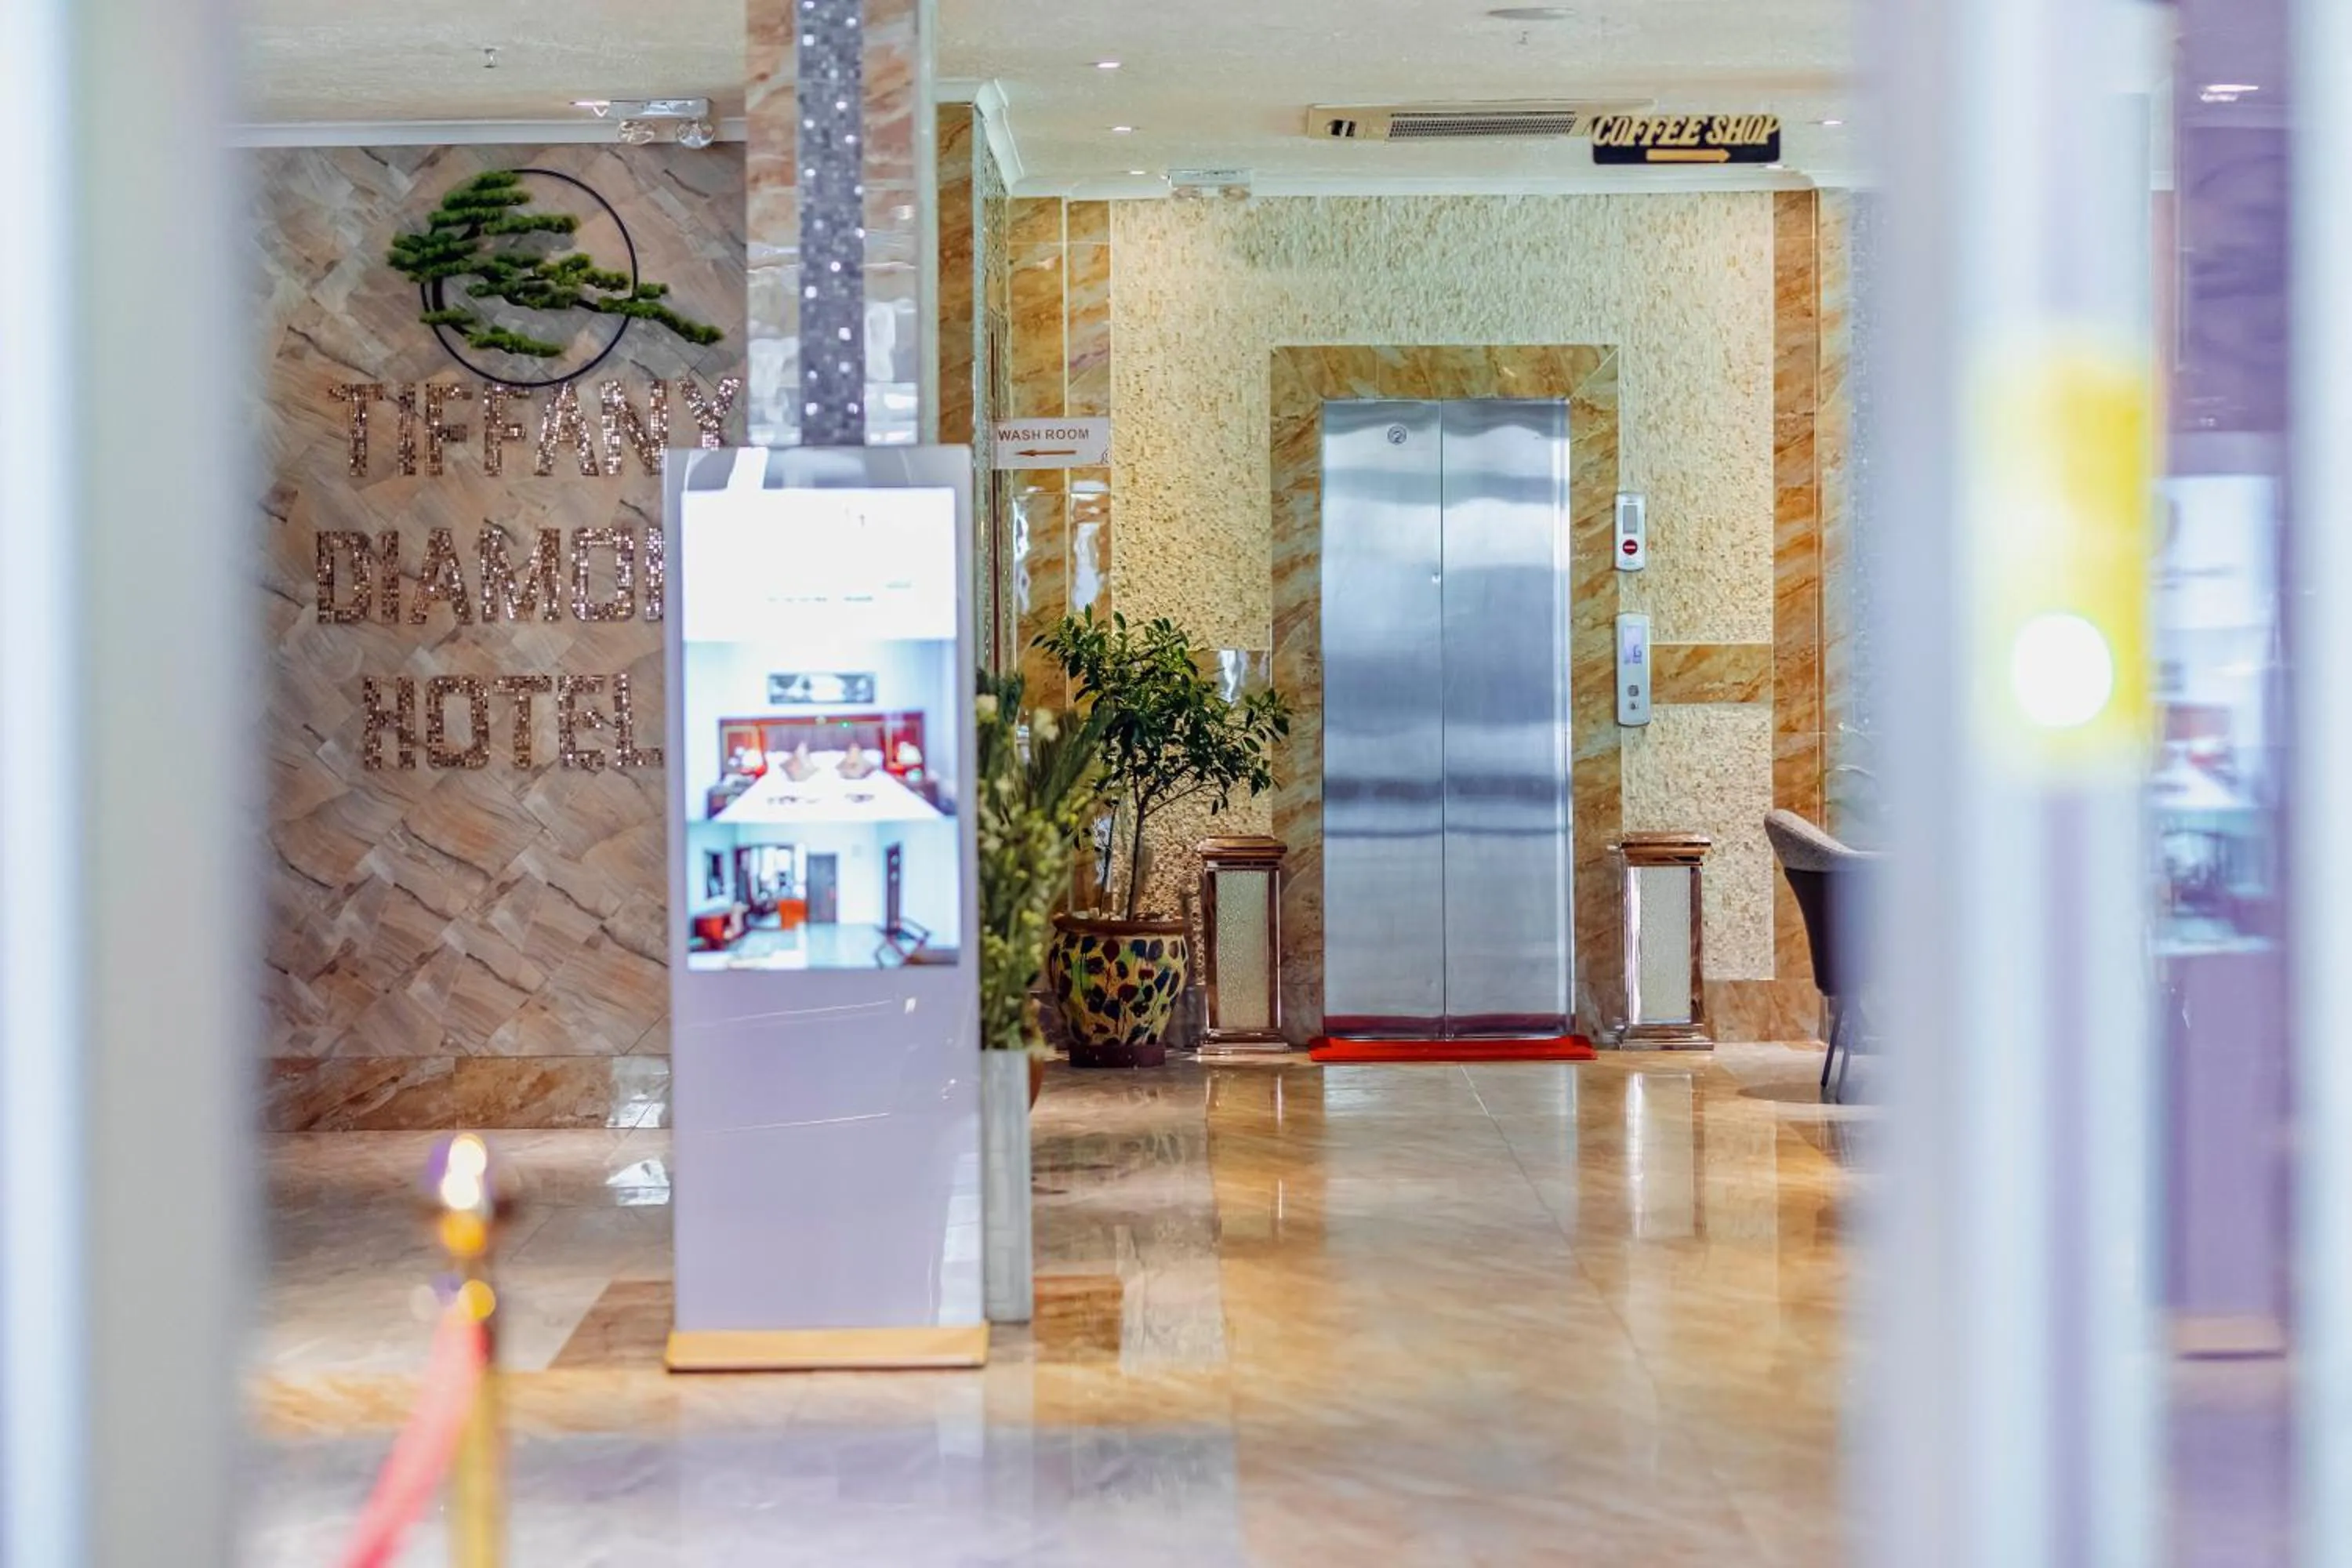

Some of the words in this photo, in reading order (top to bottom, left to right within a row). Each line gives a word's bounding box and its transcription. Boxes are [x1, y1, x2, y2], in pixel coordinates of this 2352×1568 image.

[1592, 114, 1701, 146] COFFEE
[1704, 114, 1780, 145] SHOP
[328, 379, 742, 476] TIFFANY
[999, 429, 1040, 441] WASH
[1045, 429, 1089, 440] ROOM
[362, 674, 664, 770] HOTEL
